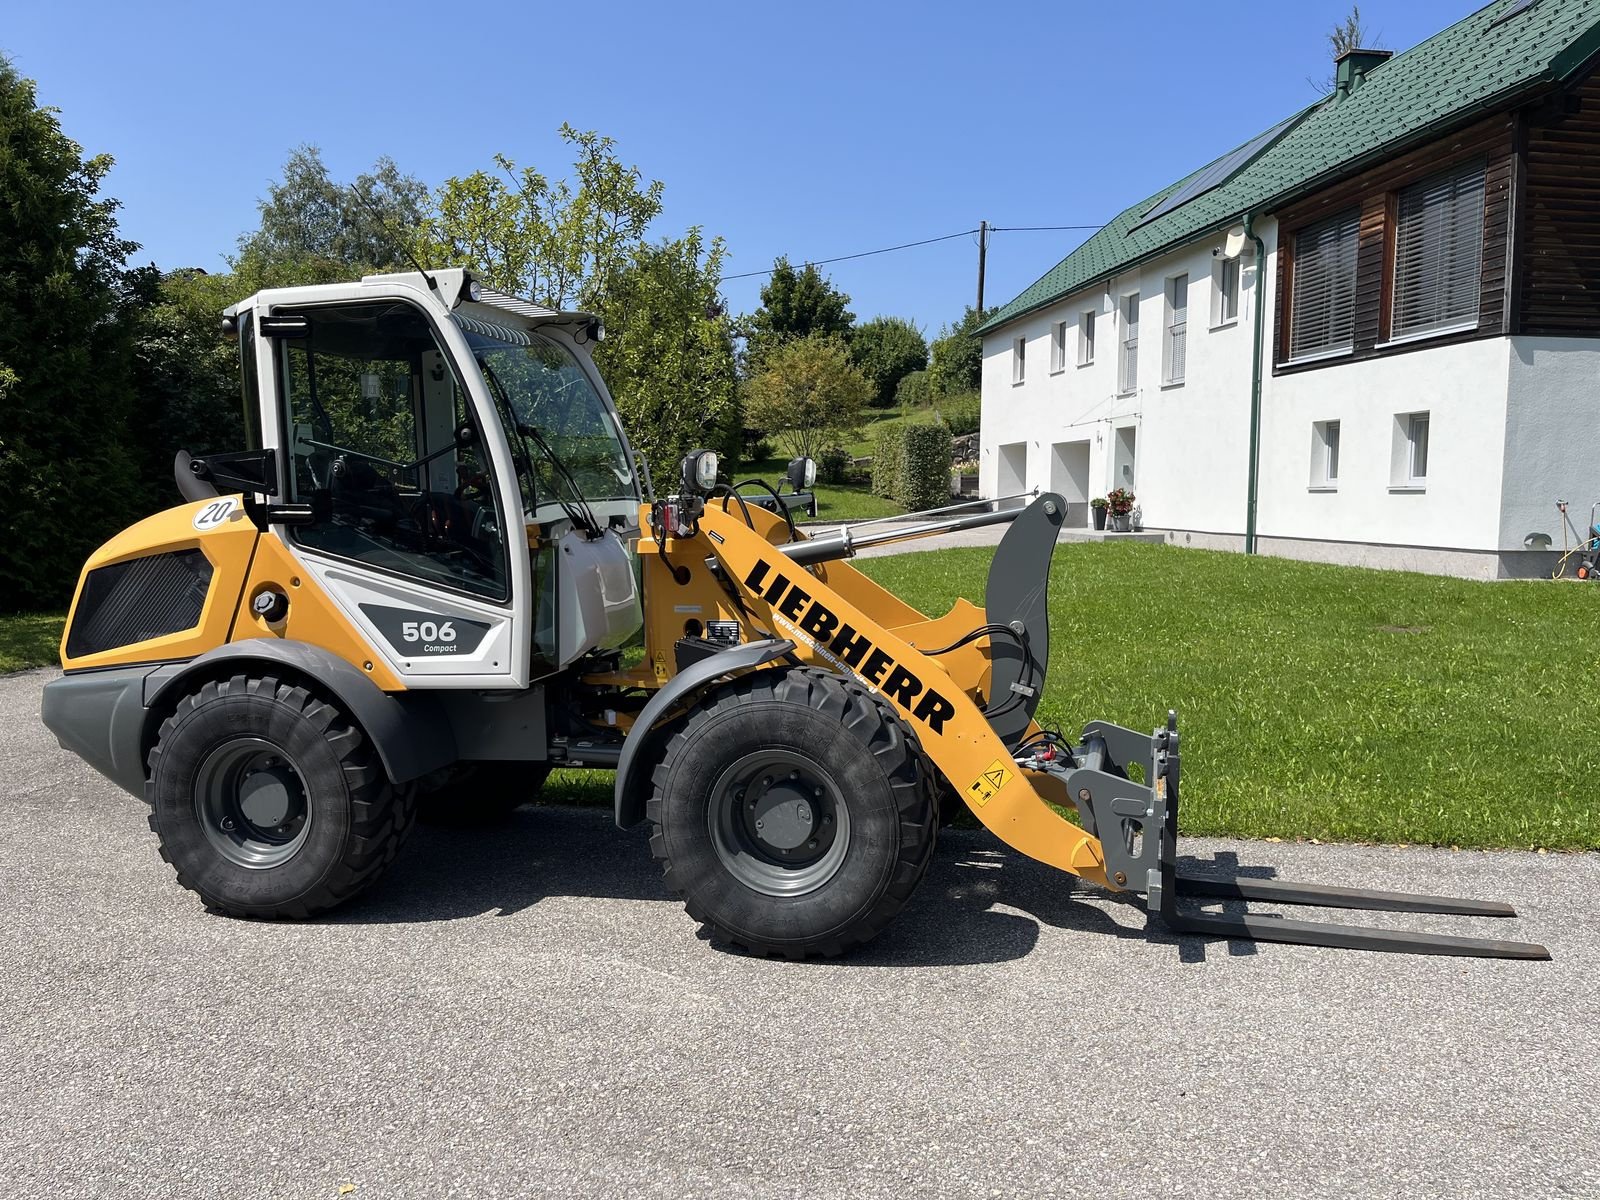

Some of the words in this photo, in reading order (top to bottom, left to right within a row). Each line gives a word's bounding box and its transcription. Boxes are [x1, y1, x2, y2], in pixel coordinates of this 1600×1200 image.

[197, 501, 233, 524] 20
[402, 621, 457, 642] 506
[423, 644, 457, 654] Compact
[744, 558, 955, 736] LIEBHERR
